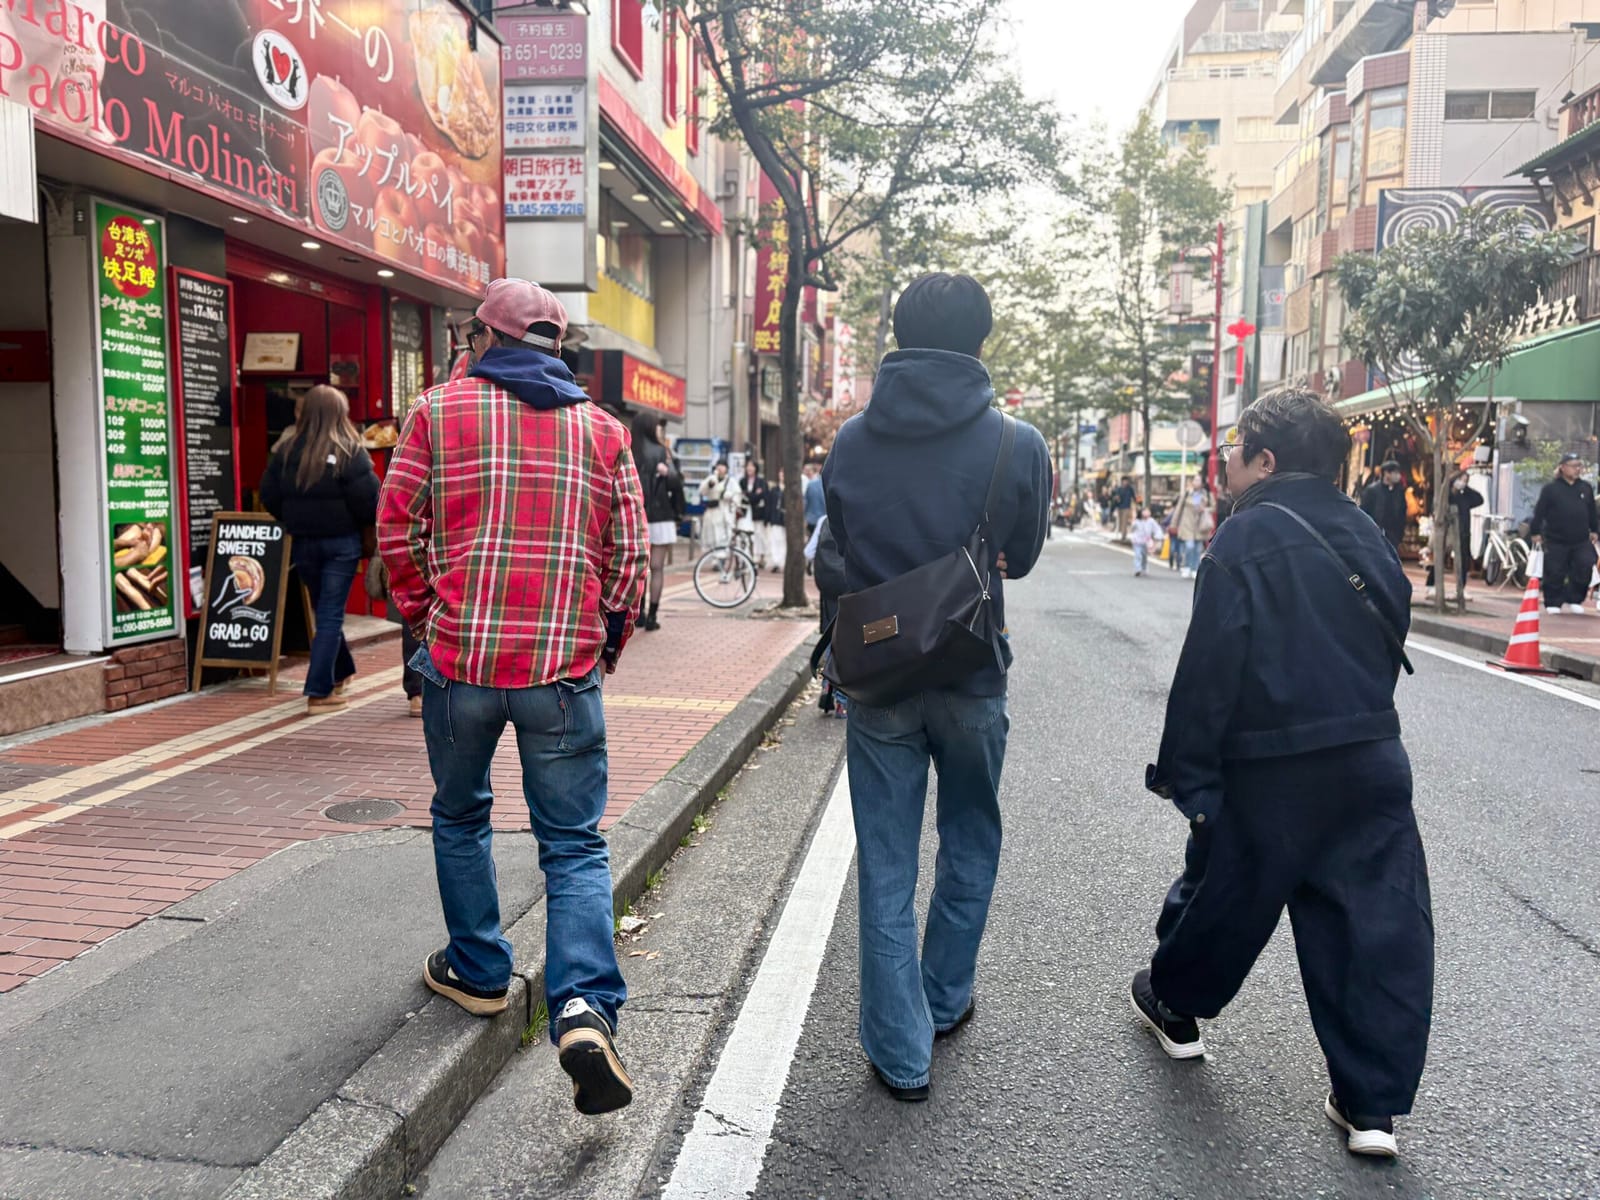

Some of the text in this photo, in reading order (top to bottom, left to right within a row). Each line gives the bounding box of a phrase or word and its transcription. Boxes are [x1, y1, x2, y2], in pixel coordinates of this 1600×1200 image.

[516, 23, 567, 37] 予約優先
[515, 42, 583, 60] 651-0239
[164, 70, 205, 104] マルコ
[206, 86, 243, 122] パオロ
[0, 31, 131, 142] Paolo
[143, 97, 299, 213] Molinari
[328, 112, 454, 225] アップルパイ
[504, 157, 583, 176] 朝日旅行社
[107, 221, 150, 248] 台湾式
[350, 201, 490, 284] マルコとパオロの横浜物語
[103, 256, 156, 289] 快足館
[101, 294, 163, 319] タイムサービス
[120, 313, 148, 331] コース
[107, 415, 166, 430] 10分 1000円
[218, 525, 282, 541] HANDHELD
[217, 541, 266, 556] SWEETS
[209, 623, 241, 641] GRAB
[250, 625, 269, 642] GO
